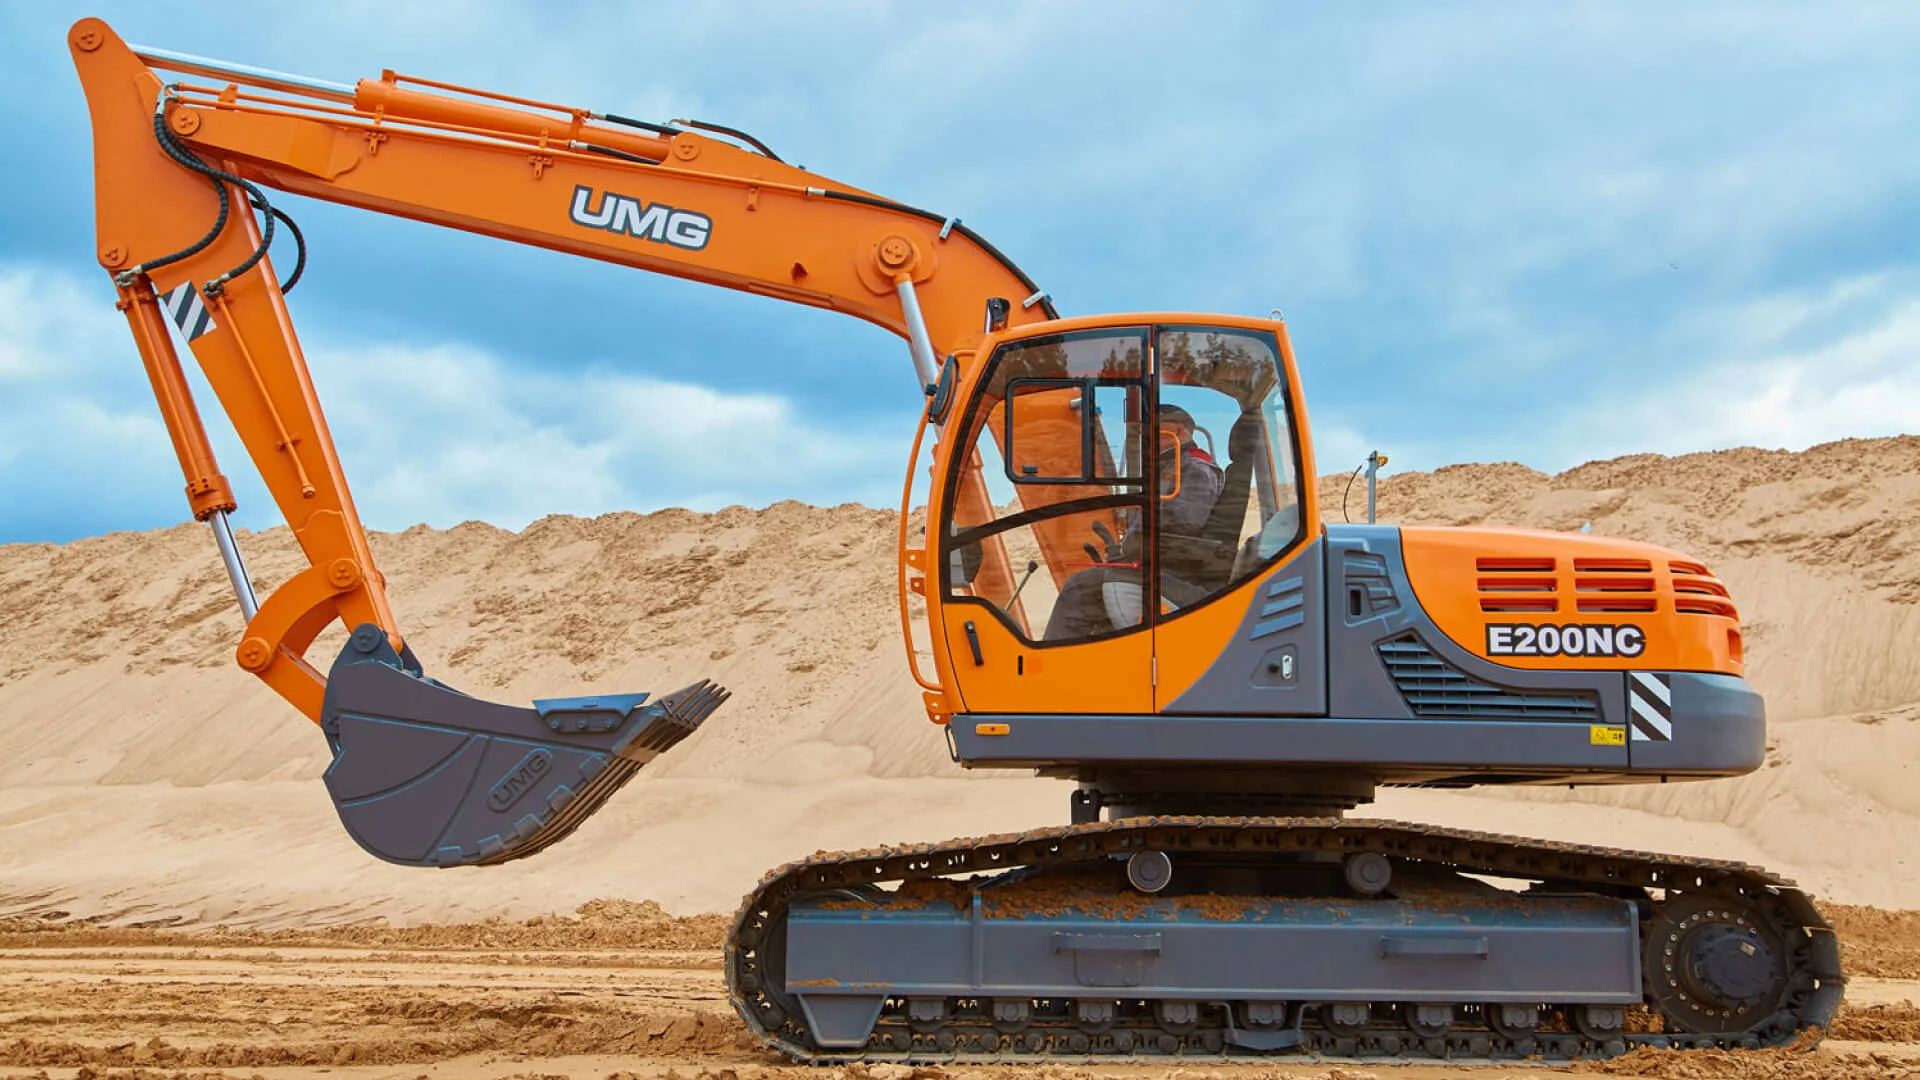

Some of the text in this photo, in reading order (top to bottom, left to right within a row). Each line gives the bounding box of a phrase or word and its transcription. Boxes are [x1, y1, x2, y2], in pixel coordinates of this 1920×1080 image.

[570, 186, 712, 249] UMG
[1487, 625, 1645, 656] E200NC
[493, 754, 546, 804] UMG
